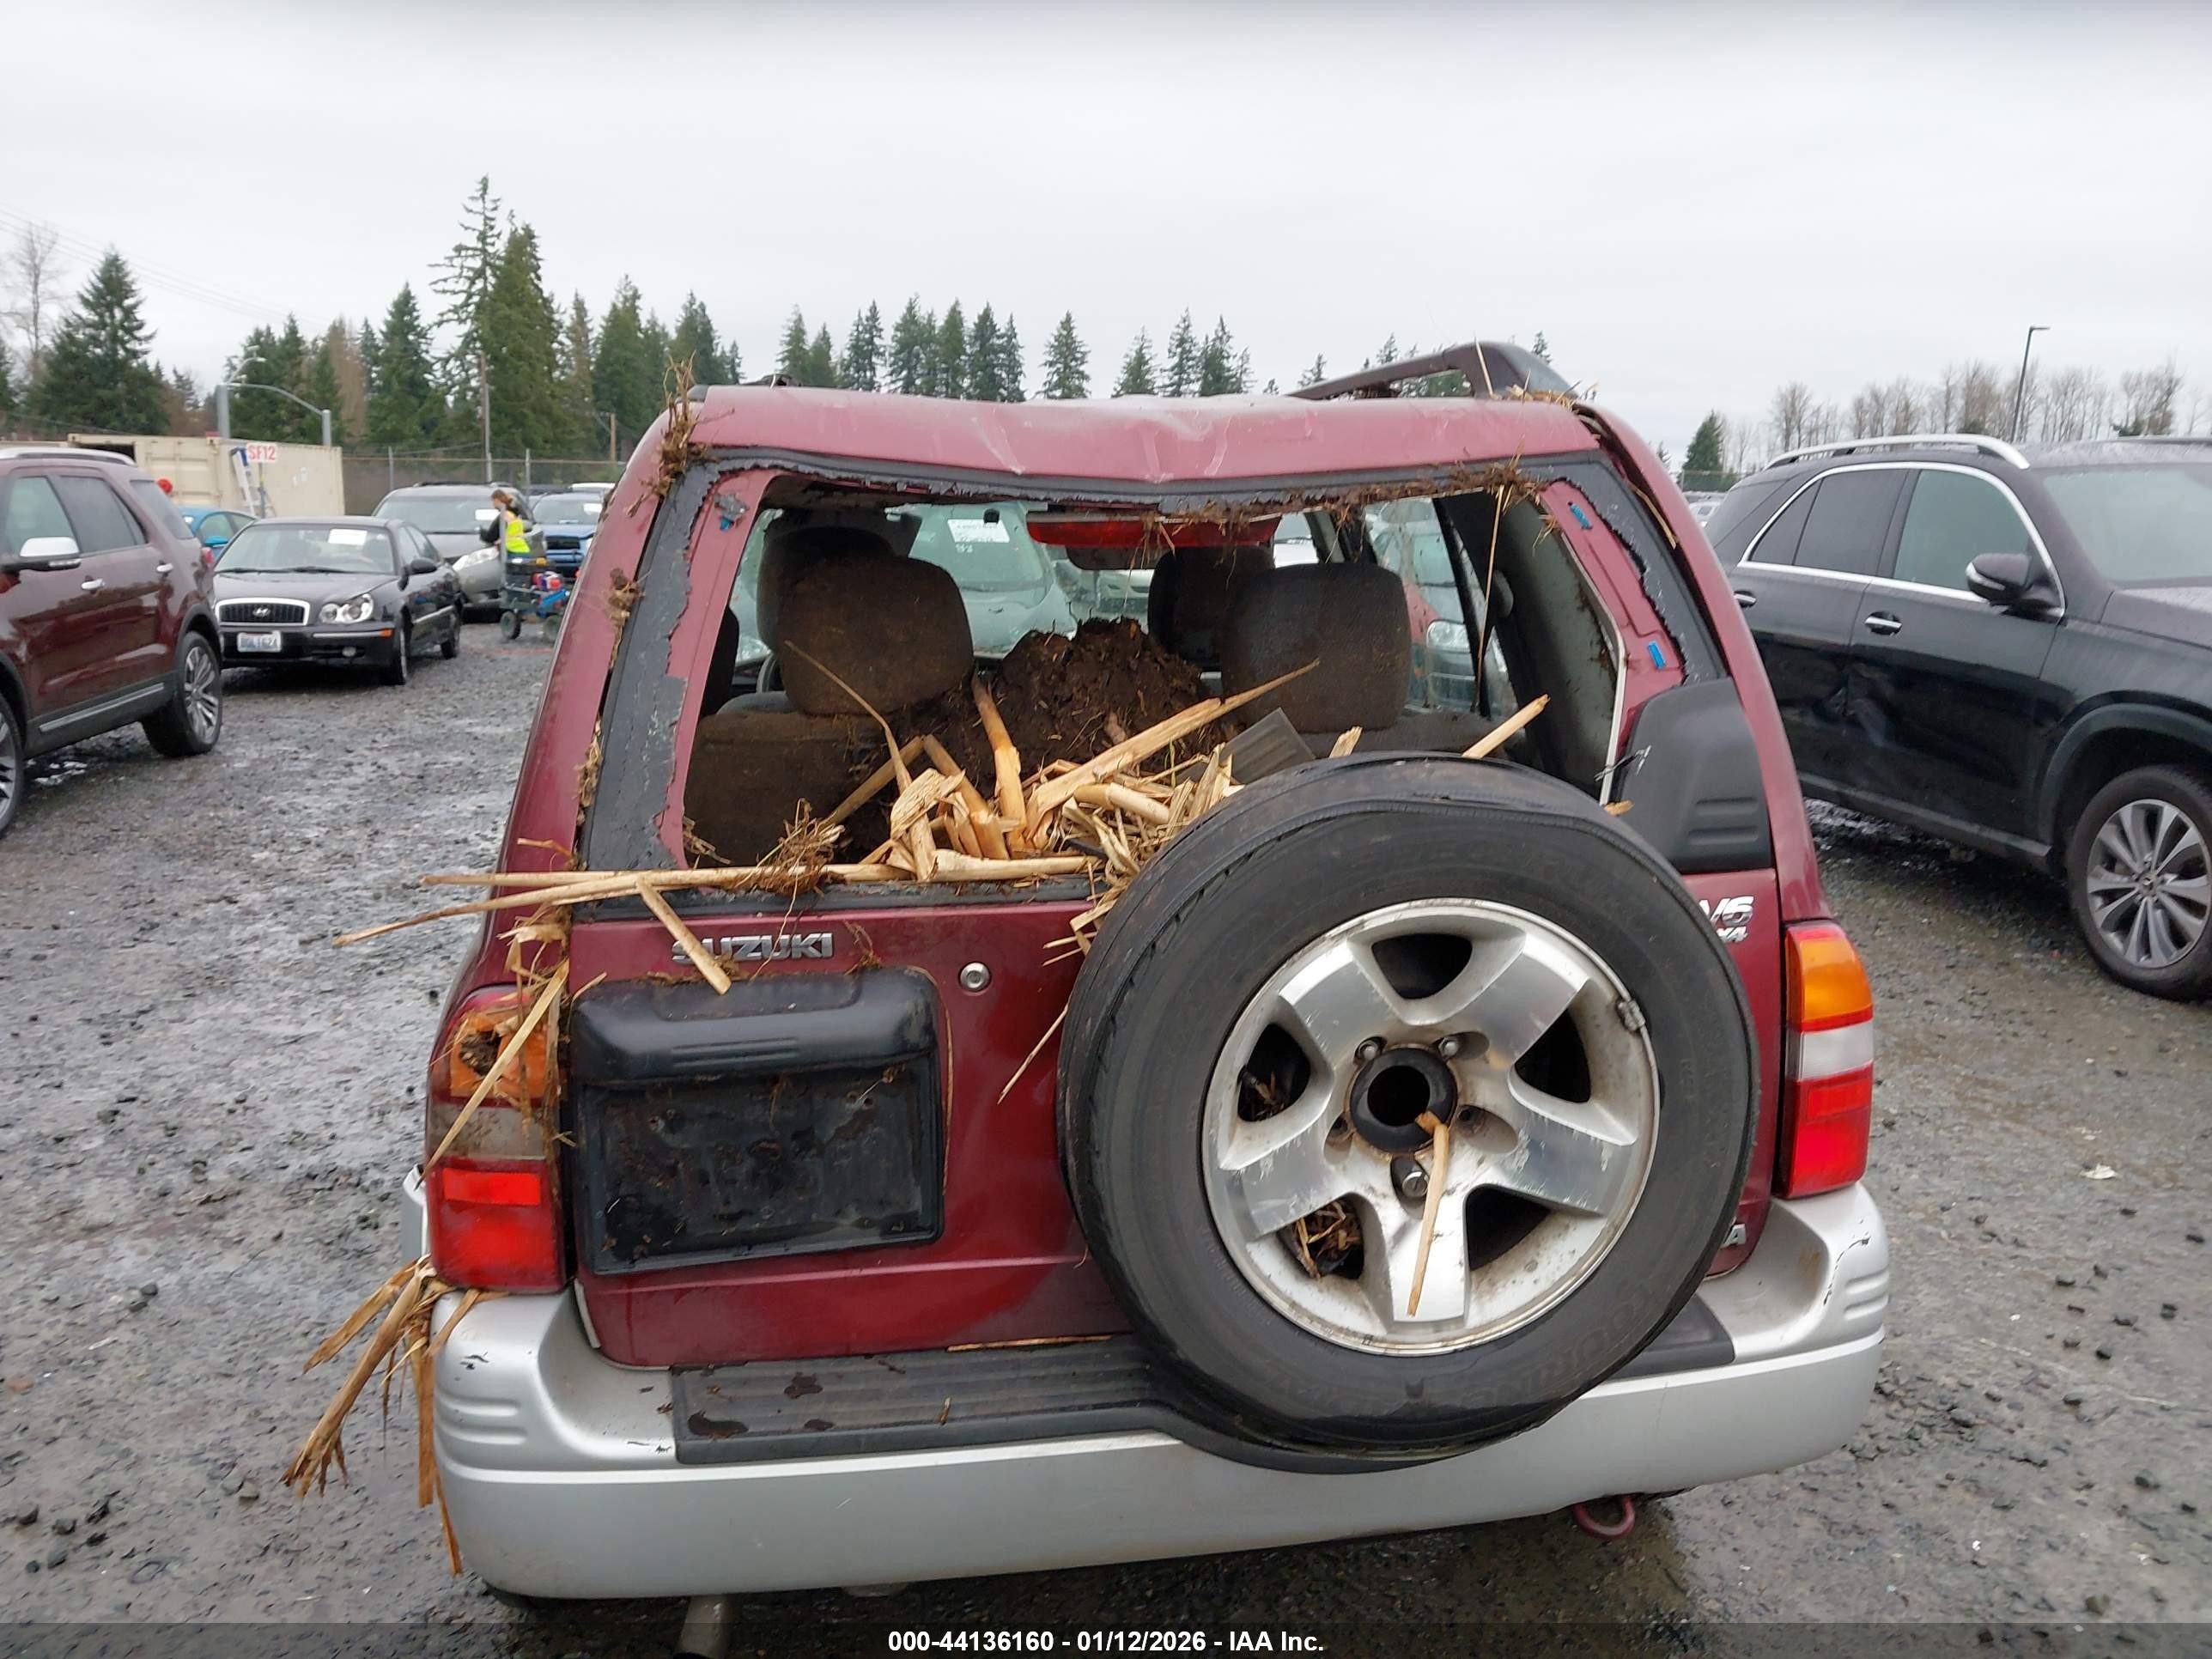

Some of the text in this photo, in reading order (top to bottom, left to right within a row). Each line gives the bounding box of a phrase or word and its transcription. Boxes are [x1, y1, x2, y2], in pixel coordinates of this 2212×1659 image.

[247, 445, 276, 461] SF12
[1699, 896, 1754, 927] V6
[1717, 927, 1748, 943] X4
